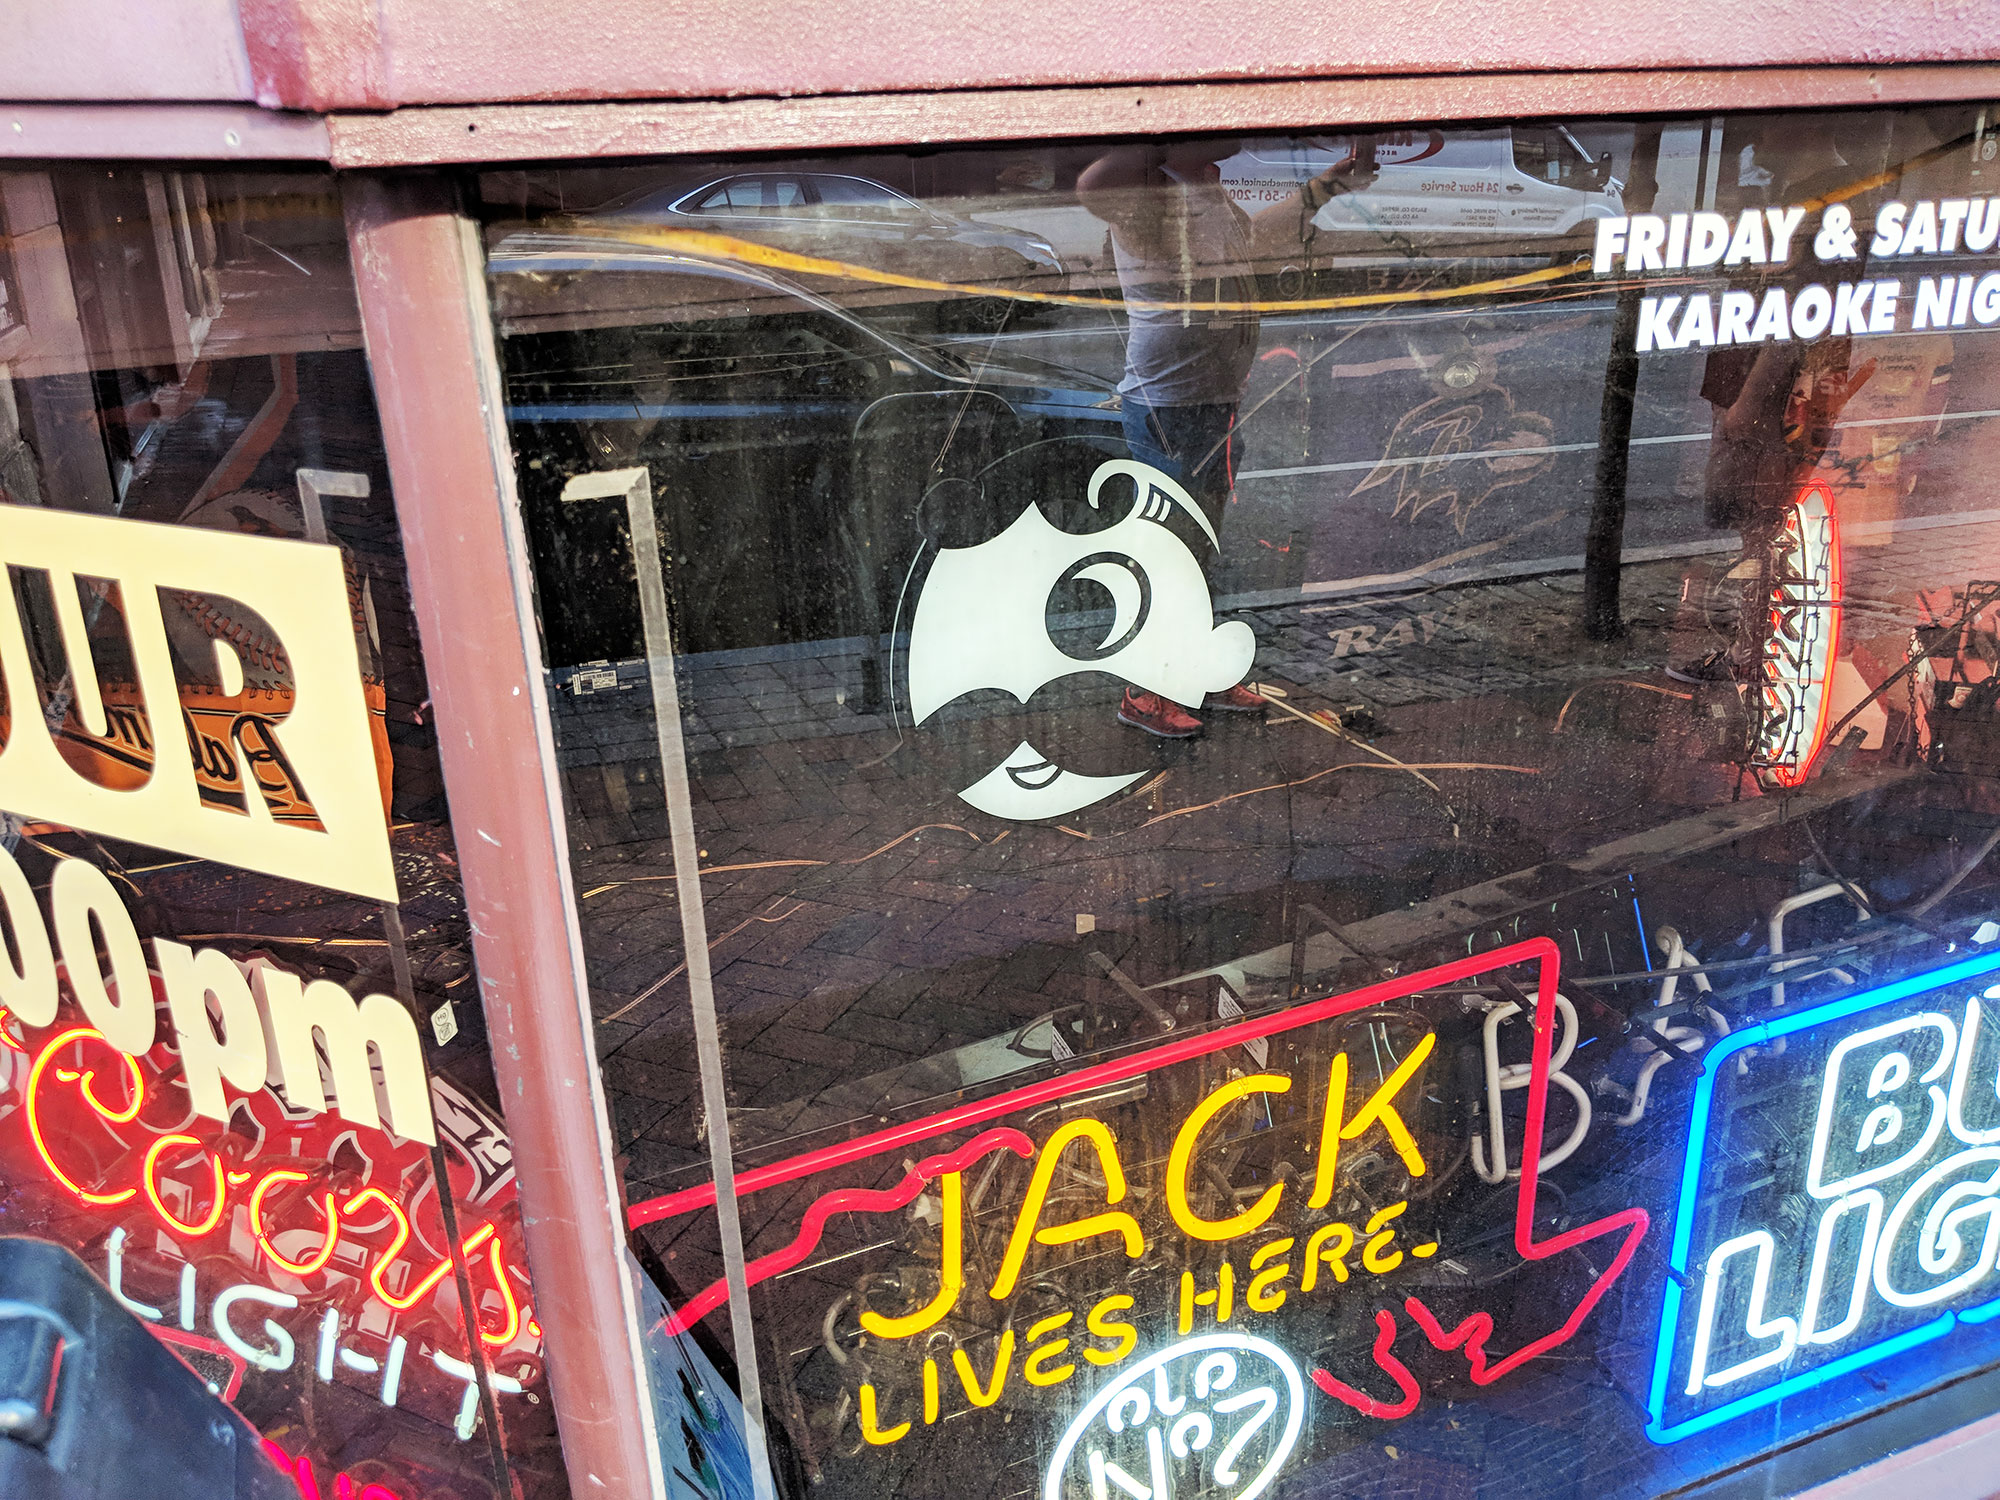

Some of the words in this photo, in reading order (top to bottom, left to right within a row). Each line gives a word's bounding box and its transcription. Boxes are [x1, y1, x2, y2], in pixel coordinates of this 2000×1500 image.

[1592, 206, 1808, 274] FRIDAY
[1813, 203, 1857, 262] &
[1870, 198, 2000, 258] SATU
[1635, 278, 1901, 353] KARAOKE
[1911, 271, 2000, 330] NIG
[0, 562, 329, 834] UR
[860, 1033, 1436, 1339] JACK
[1684, 1145, 2000, 1396] LIG
[109, 1226, 523, 1441] LIGHT
[860, 1294, 1138, 1445] LIVES
